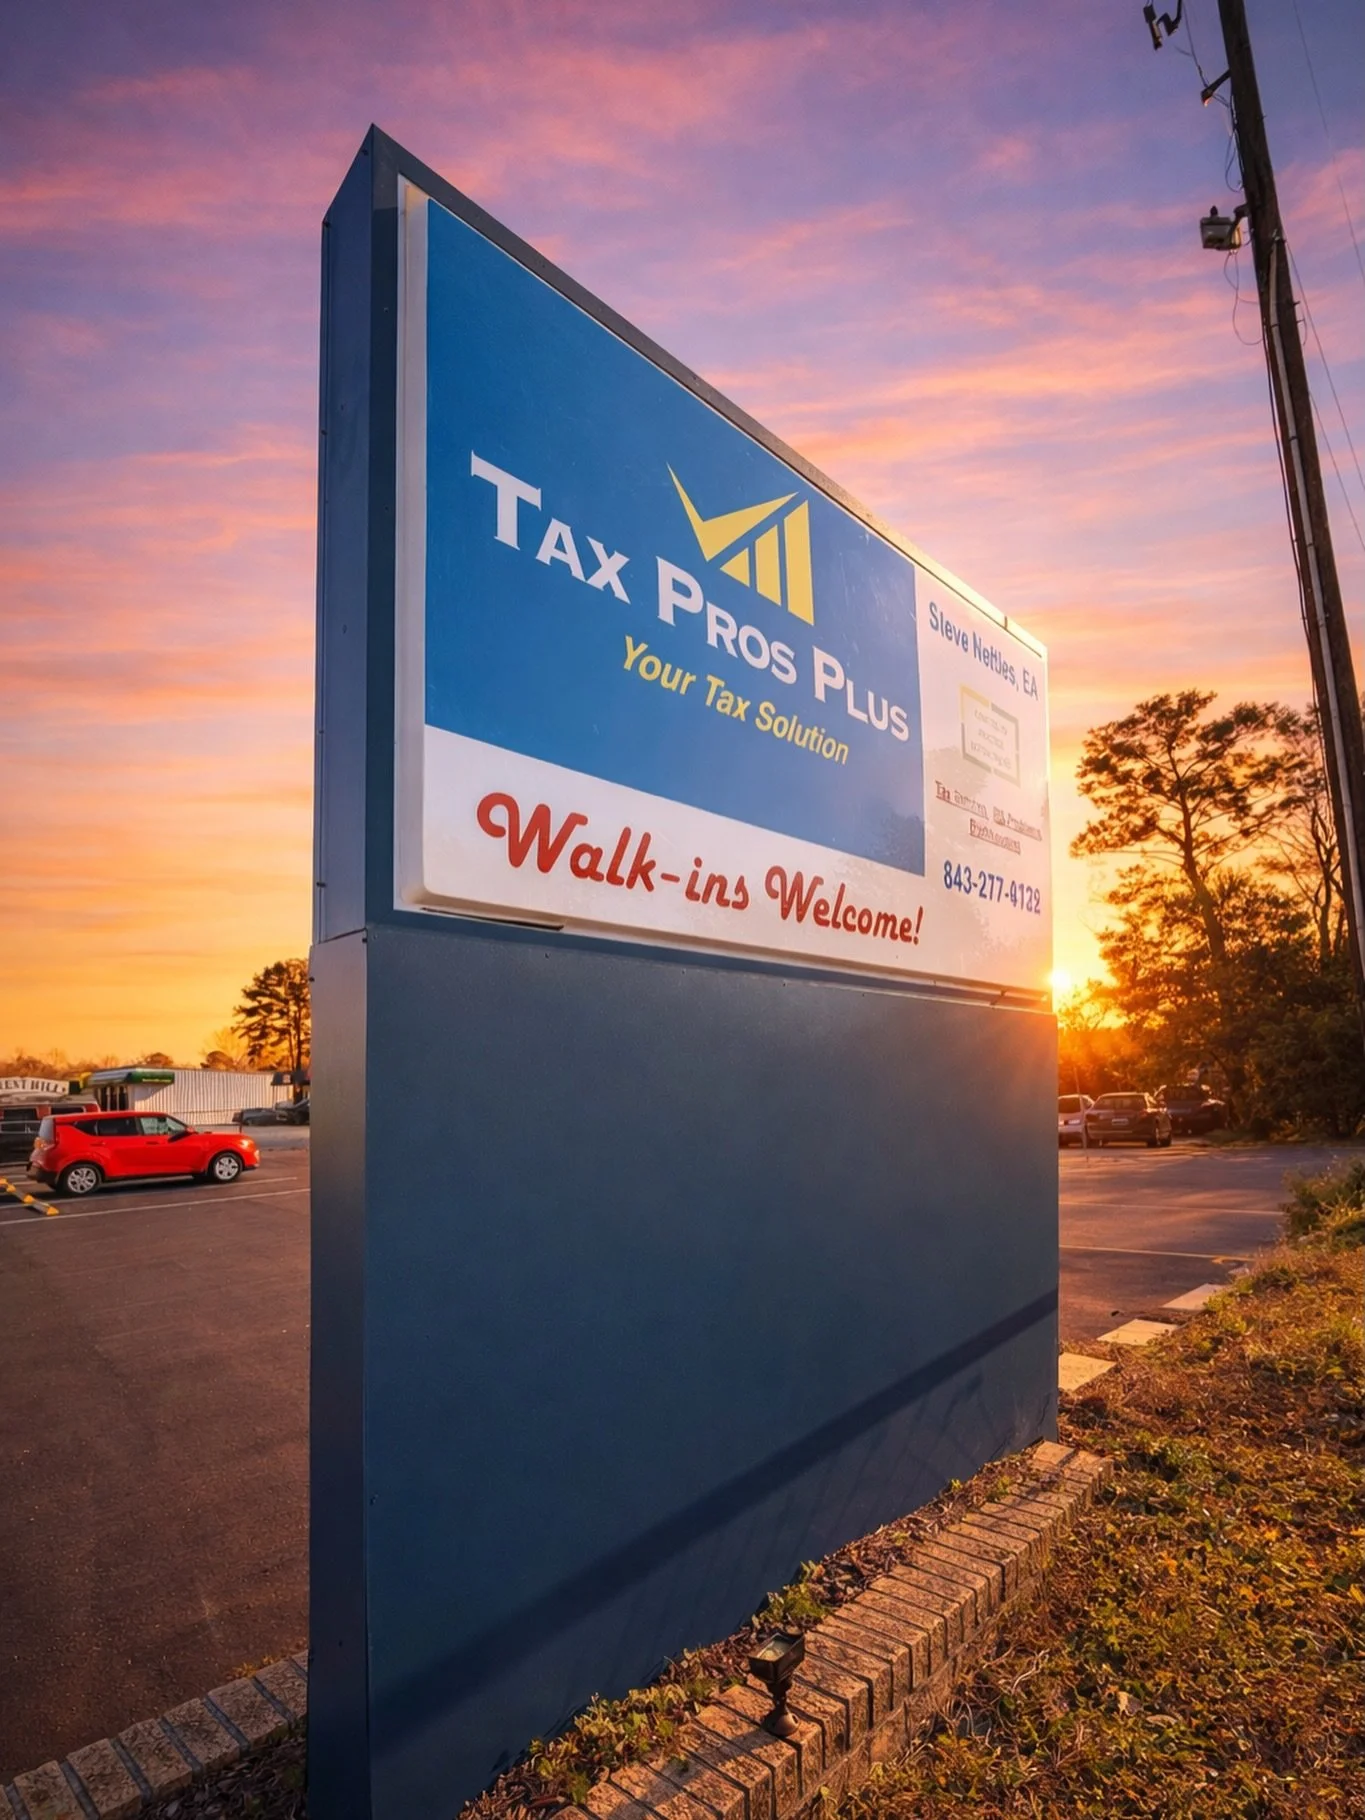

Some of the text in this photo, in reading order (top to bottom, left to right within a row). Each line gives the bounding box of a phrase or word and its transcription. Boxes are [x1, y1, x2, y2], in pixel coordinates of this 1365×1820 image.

[470, 451, 910, 743] TAX PROS PLUS
[624, 636, 849, 766] Your Tax Solution
[1022, 667, 1039, 701] EA
[476, 792, 925, 945] Walk-ins Welcome!
